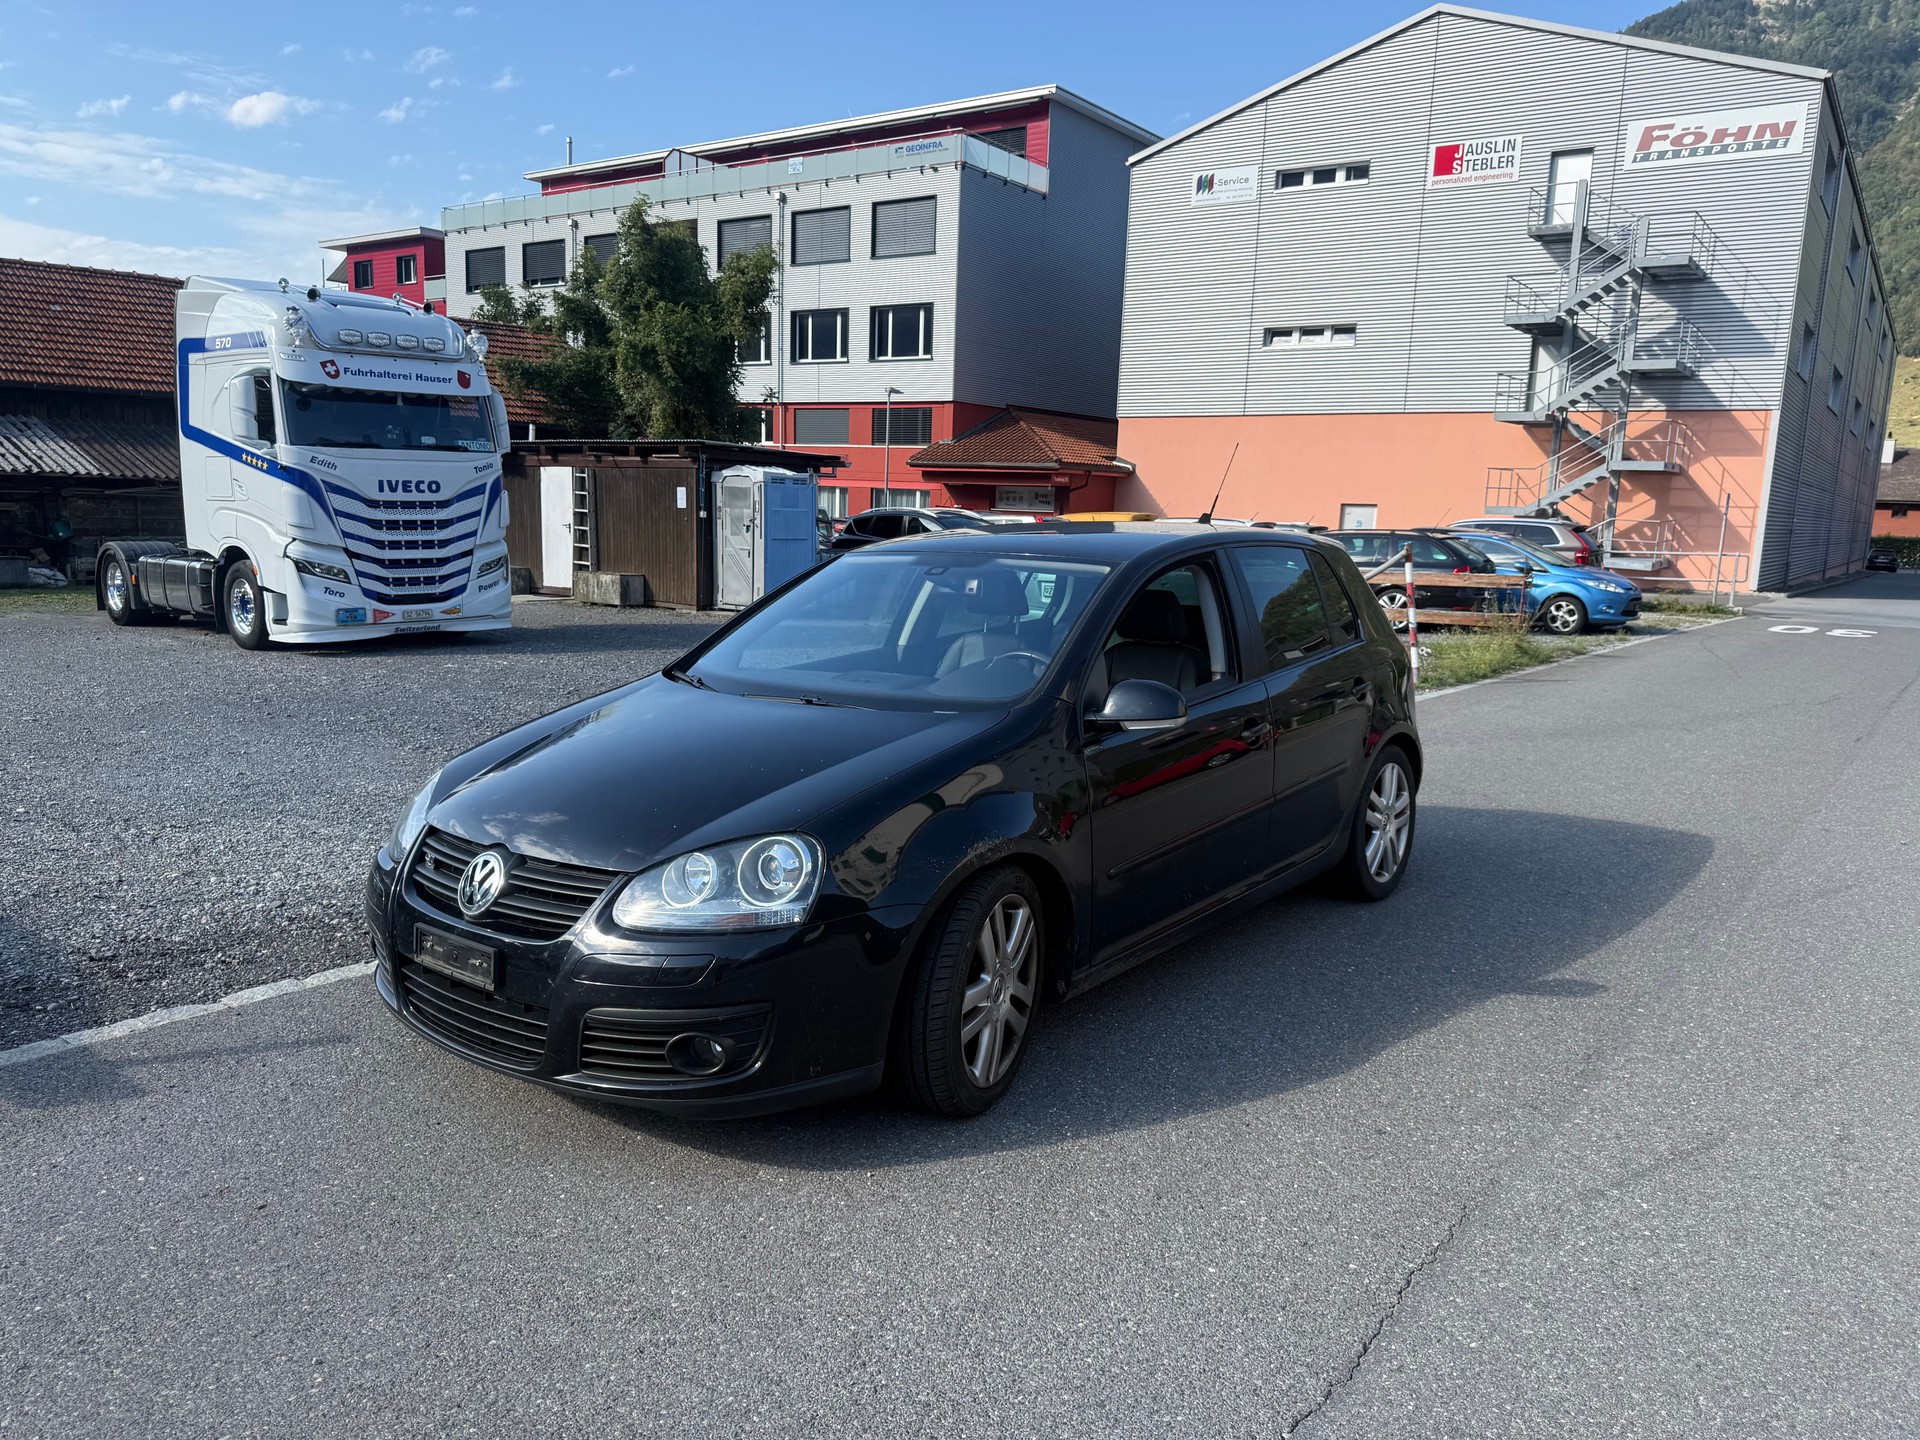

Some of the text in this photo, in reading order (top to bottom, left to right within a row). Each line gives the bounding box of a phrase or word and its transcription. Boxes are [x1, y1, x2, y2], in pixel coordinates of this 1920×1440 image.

[1636, 120, 1797, 153] FÖHN
[905, 141, 943, 153] GEOINFRA
[1454, 138, 1517, 158] JAUSLIN
[1635, 138, 1787, 163] TRANSPORTE
[1452, 155, 1515, 174] STEBLER
[1431, 171, 1514, 187] personalized engineering
[215, 337, 231, 349] 570
[343, 367, 453, 384] Fuhrhalterei Hauser
[309, 455, 338, 471] Edith
[473, 461, 494, 474] Tonio
[378, 479, 441, 494] IVECO
[323, 586, 346, 599] Toro
[478, 579, 500, 593] Power
[394, 624, 441, 634] Switzerland
[1767, 625, 1878, 638] 30
